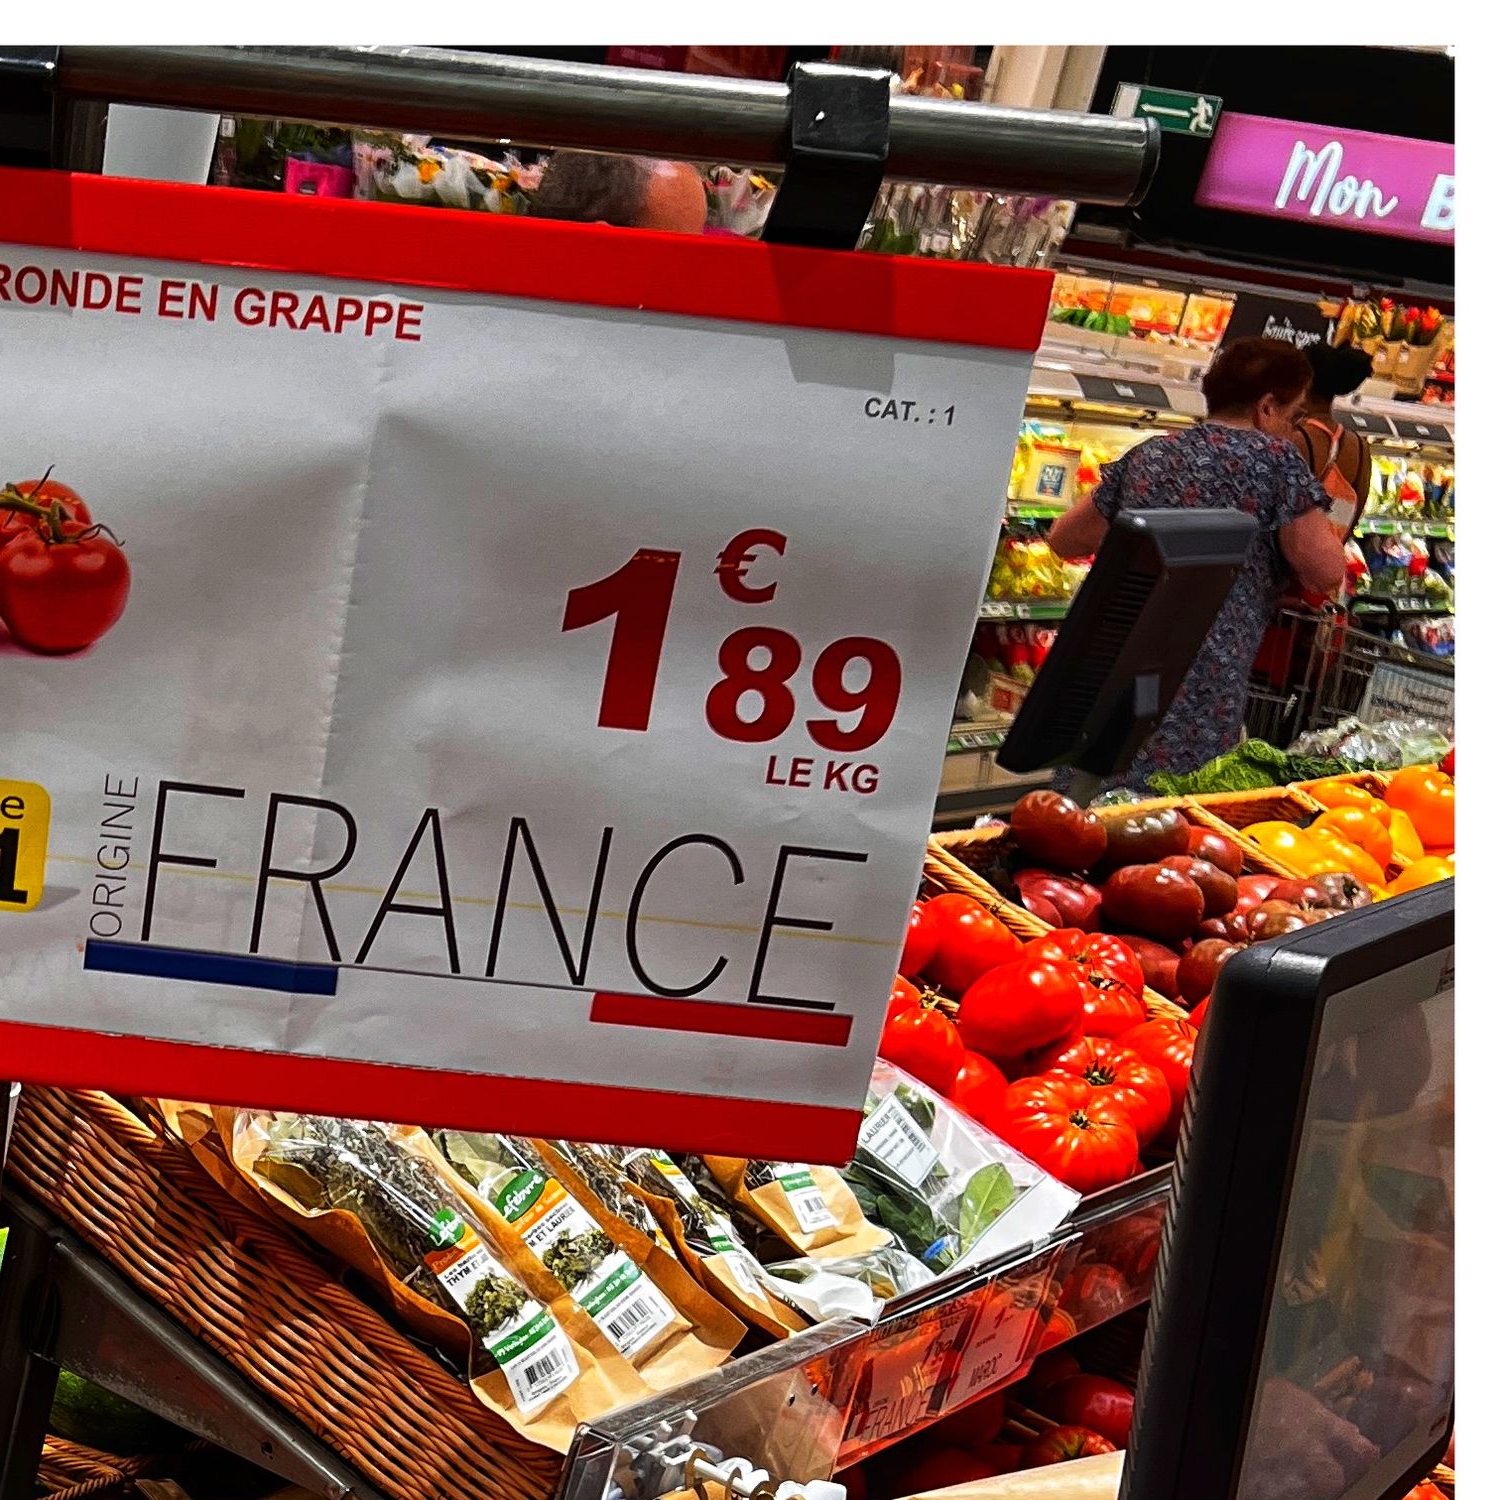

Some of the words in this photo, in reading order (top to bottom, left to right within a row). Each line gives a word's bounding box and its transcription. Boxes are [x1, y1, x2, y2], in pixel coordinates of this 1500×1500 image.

[1274, 140, 1399, 219] Mon
[157, 280, 219, 322] EN
[233, 286, 425, 342] GRAPPE
[864, 396, 922, 424] CAT.
[943, 404, 956, 427] 1
[712, 527, 788, 605] €
[561, 547, 683, 733] 1
[704, 625, 903, 753] 89
[764, 754, 814, 788] LE
[822, 760, 881, 795] KG
[88, 772, 140, 938] ORIGINE
[139, 779, 869, 1012] FRANCE
[445, 1265, 472, 1288] THYM
